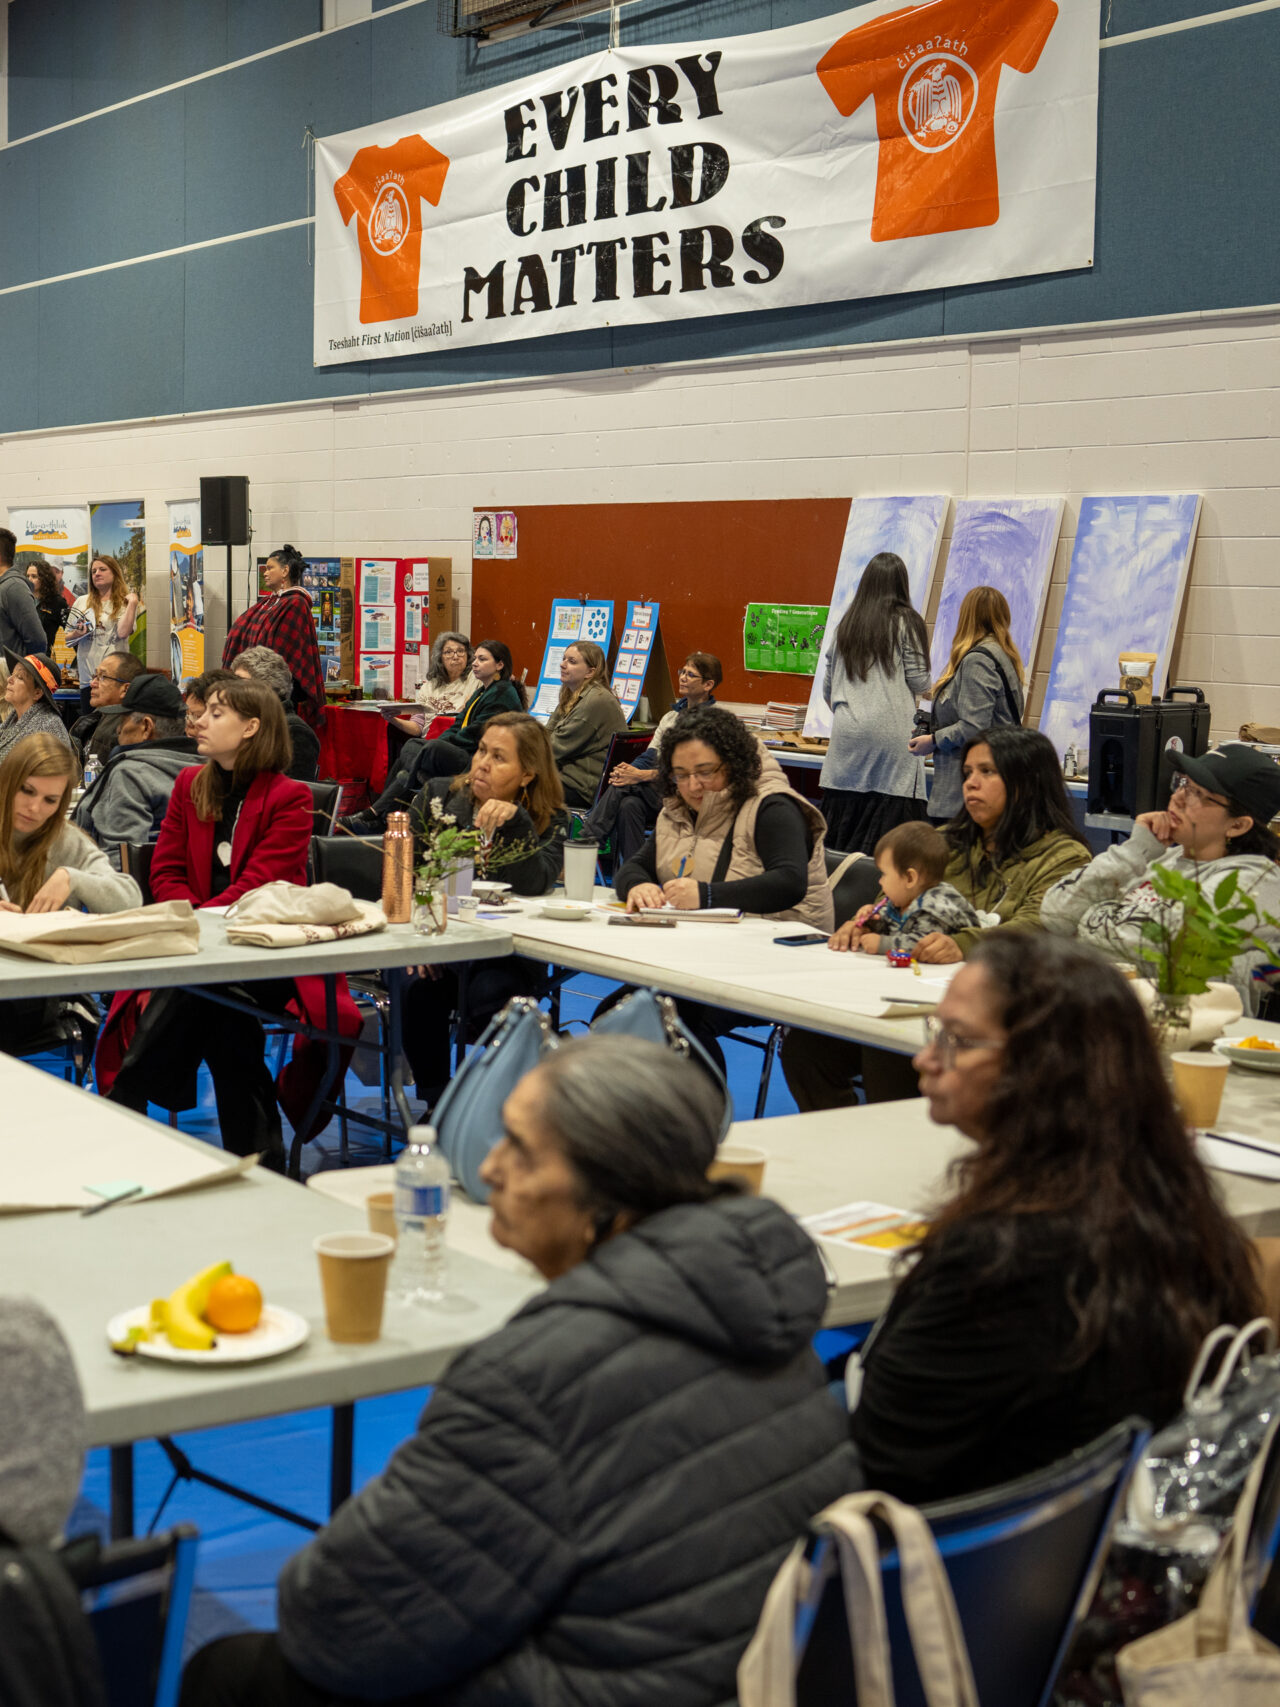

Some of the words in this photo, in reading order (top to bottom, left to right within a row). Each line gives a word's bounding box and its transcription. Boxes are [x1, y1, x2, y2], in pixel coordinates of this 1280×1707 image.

[504, 50, 725, 164] EVERY
[505, 141, 730, 238] CHILD
[460, 215, 787, 324] MATTERS
[329, 332, 361, 351] Tseshaht
[361, 332, 382, 346] First
[383, 327, 410, 343] Nation
